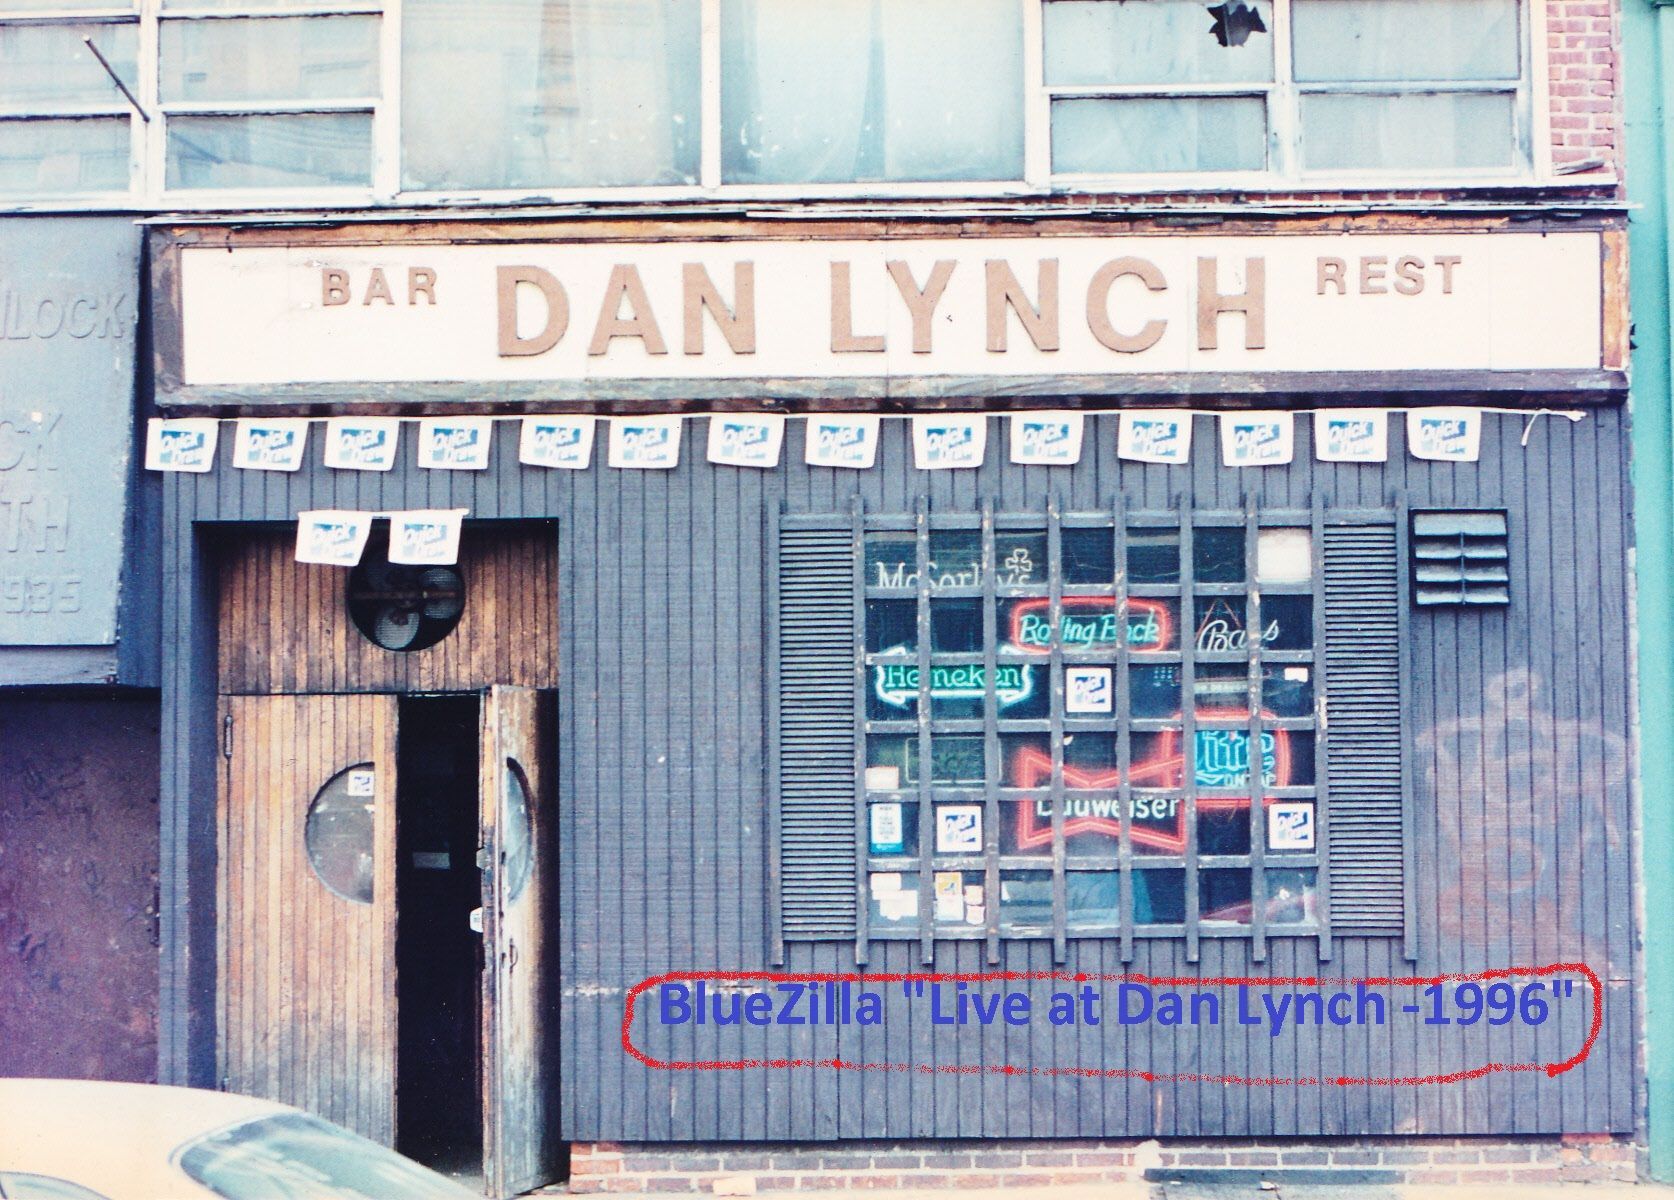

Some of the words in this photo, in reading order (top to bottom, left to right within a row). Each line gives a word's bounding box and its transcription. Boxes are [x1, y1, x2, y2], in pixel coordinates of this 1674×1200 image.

[321, 267, 438, 306] BAR
[1316, 254, 1462, 295] REST
[0, 292, 126, 338] LOCK
[497, 261, 757, 358] DAN
[829, 255, 1266, 355] LYNCH
[1198, 620, 1279, 651] Bas
[885, 665, 1020, 687] Henekn
